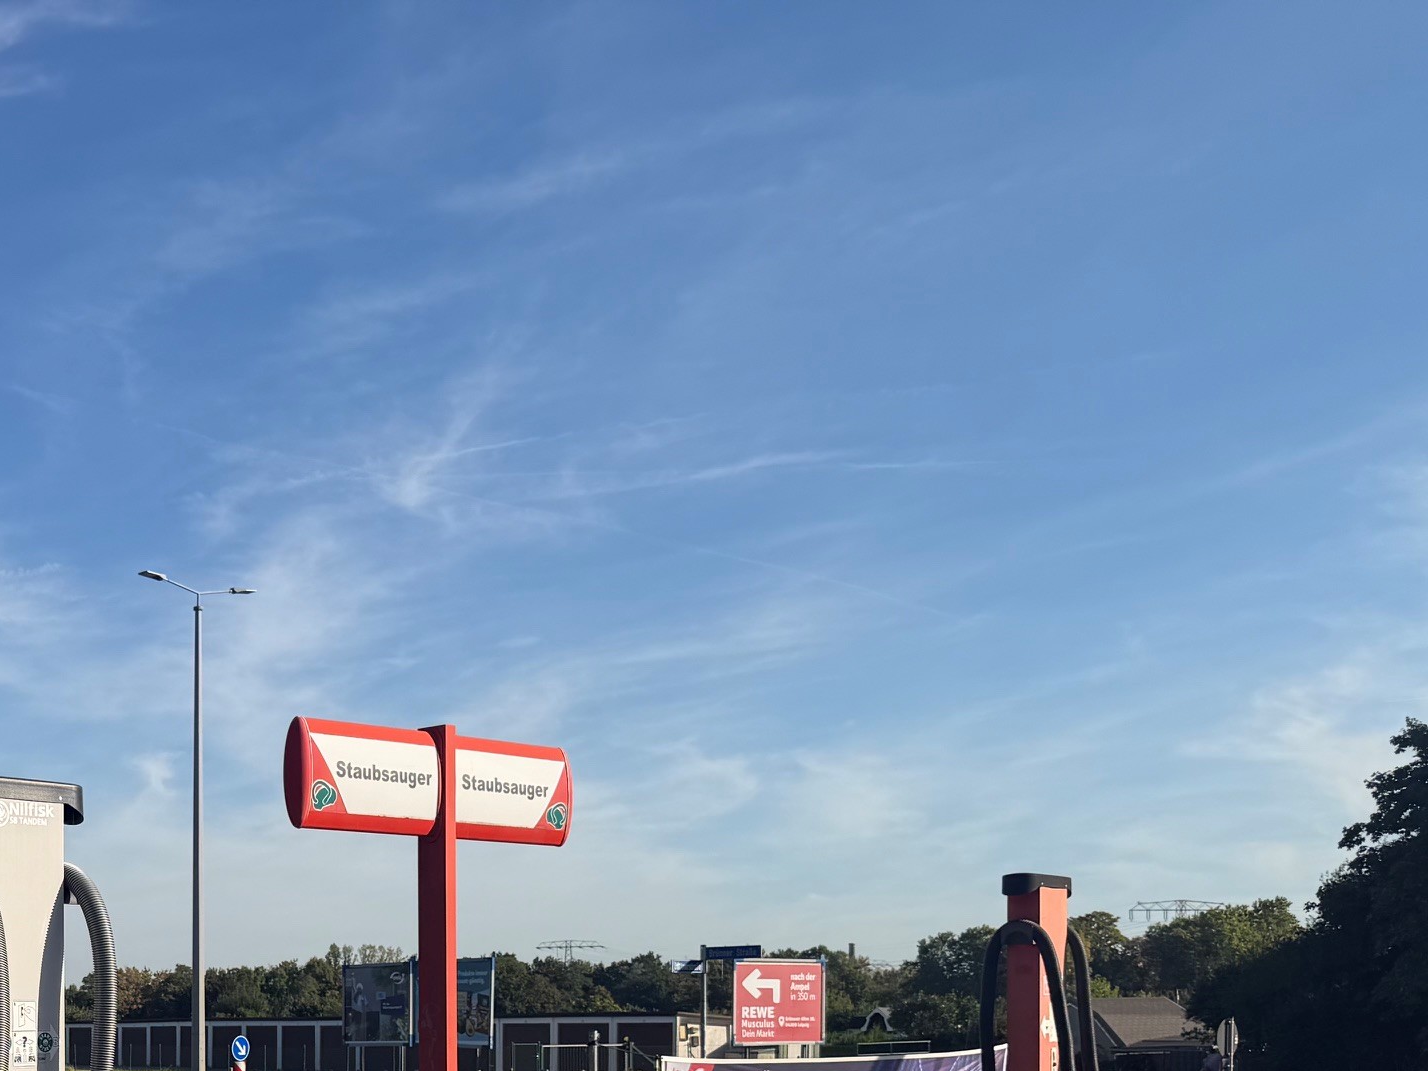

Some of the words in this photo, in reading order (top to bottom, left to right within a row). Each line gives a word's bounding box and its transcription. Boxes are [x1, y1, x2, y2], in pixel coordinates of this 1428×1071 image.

[336, 760, 432, 789] Staubsauger
[462, 773, 549, 800] Staubsauger
[9, 802, 54, 818] Nilfisk
[19, 817, 48, 826] TANDEM
[790, 982, 810, 992] Ampel
[790, 992, 796, 1000] in
[741, 1006, 775, 1018] REWE
[741, 1019, 775, 1028] Musculus
[741, 1030, 755, 1038] Dein
[755, 1029, 775, 1037] Markt
